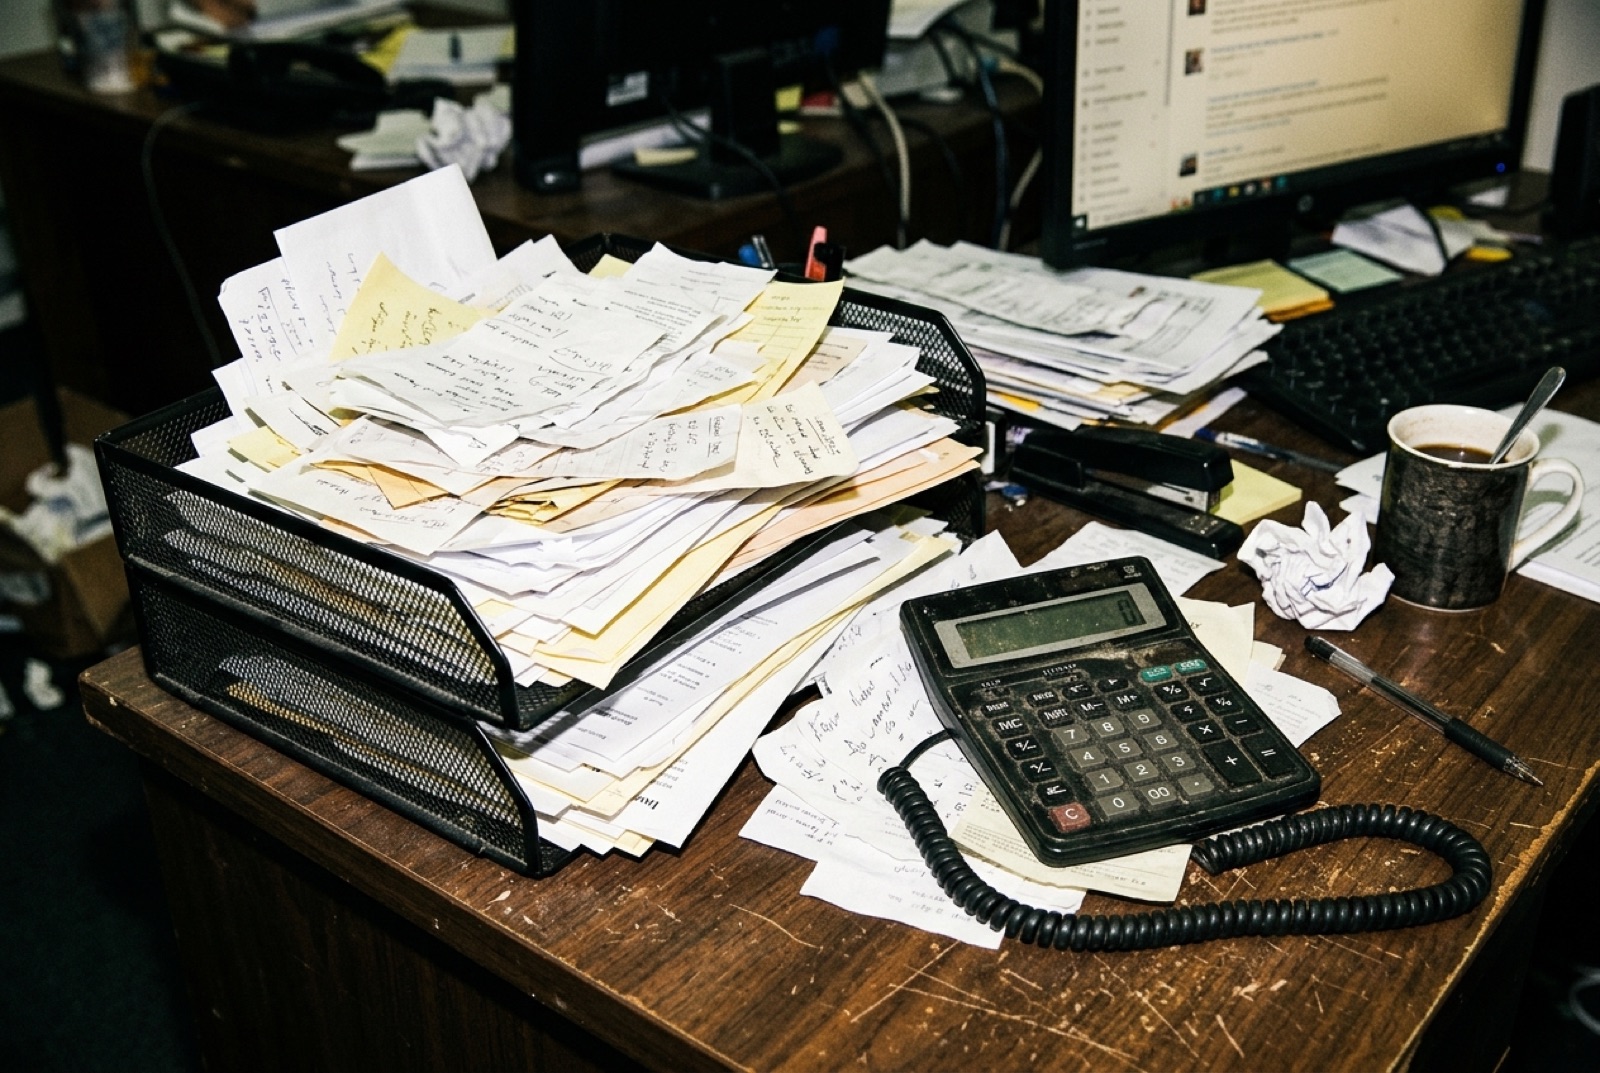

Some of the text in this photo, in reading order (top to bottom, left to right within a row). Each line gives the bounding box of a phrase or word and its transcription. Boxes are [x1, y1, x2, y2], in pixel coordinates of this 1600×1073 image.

[1117, 599, 1137, 625] 0
[1063, 728, 1076, 740] 7
[1137, 713, 1150, 724] 9
[1099, 773, 1110, 785] 1
[1135, 763, 1149, 775] 2
[1171, 756, 1186, 767] 3
[1147, 786, 1171, 799] 00
[1065, 808, 1078, 820] C
